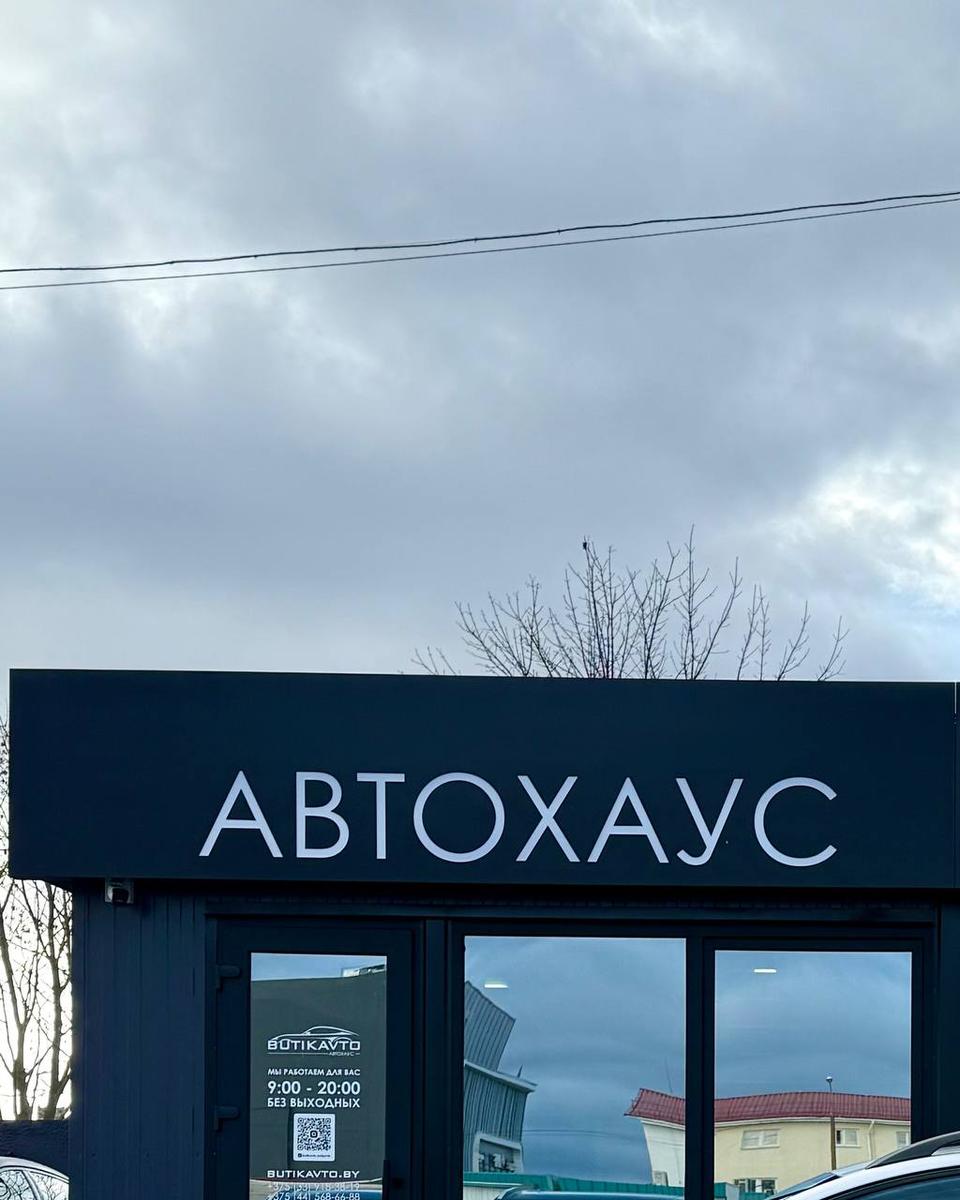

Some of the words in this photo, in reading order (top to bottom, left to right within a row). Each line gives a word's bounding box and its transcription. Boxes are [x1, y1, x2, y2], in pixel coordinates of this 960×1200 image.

[199, 770, 837, 868] АВТОХАУС
[267, 1040, 360, 1051] BUTIKAVTO
[267, 1068, 281, 1076] МЫ
[283, 1068, 324, 1076] РАБОТАЕМ
[326, 1068, 342, 1076] ДЛЯ
[344, 1068, 360, 1076] ВАС
[267, 1081, 301, 1094] 9:00
[317, 1081, 360, 1095] 20:00
[267, 1097, 286, 1108] БЕЗ
[290, 1098, 360, 1109] ВЫХОДНЫХ
[267, 1170, 360, 1178] BUTIKAVTO.BY
[314, 1192, 360, 1200] 568-66-88
